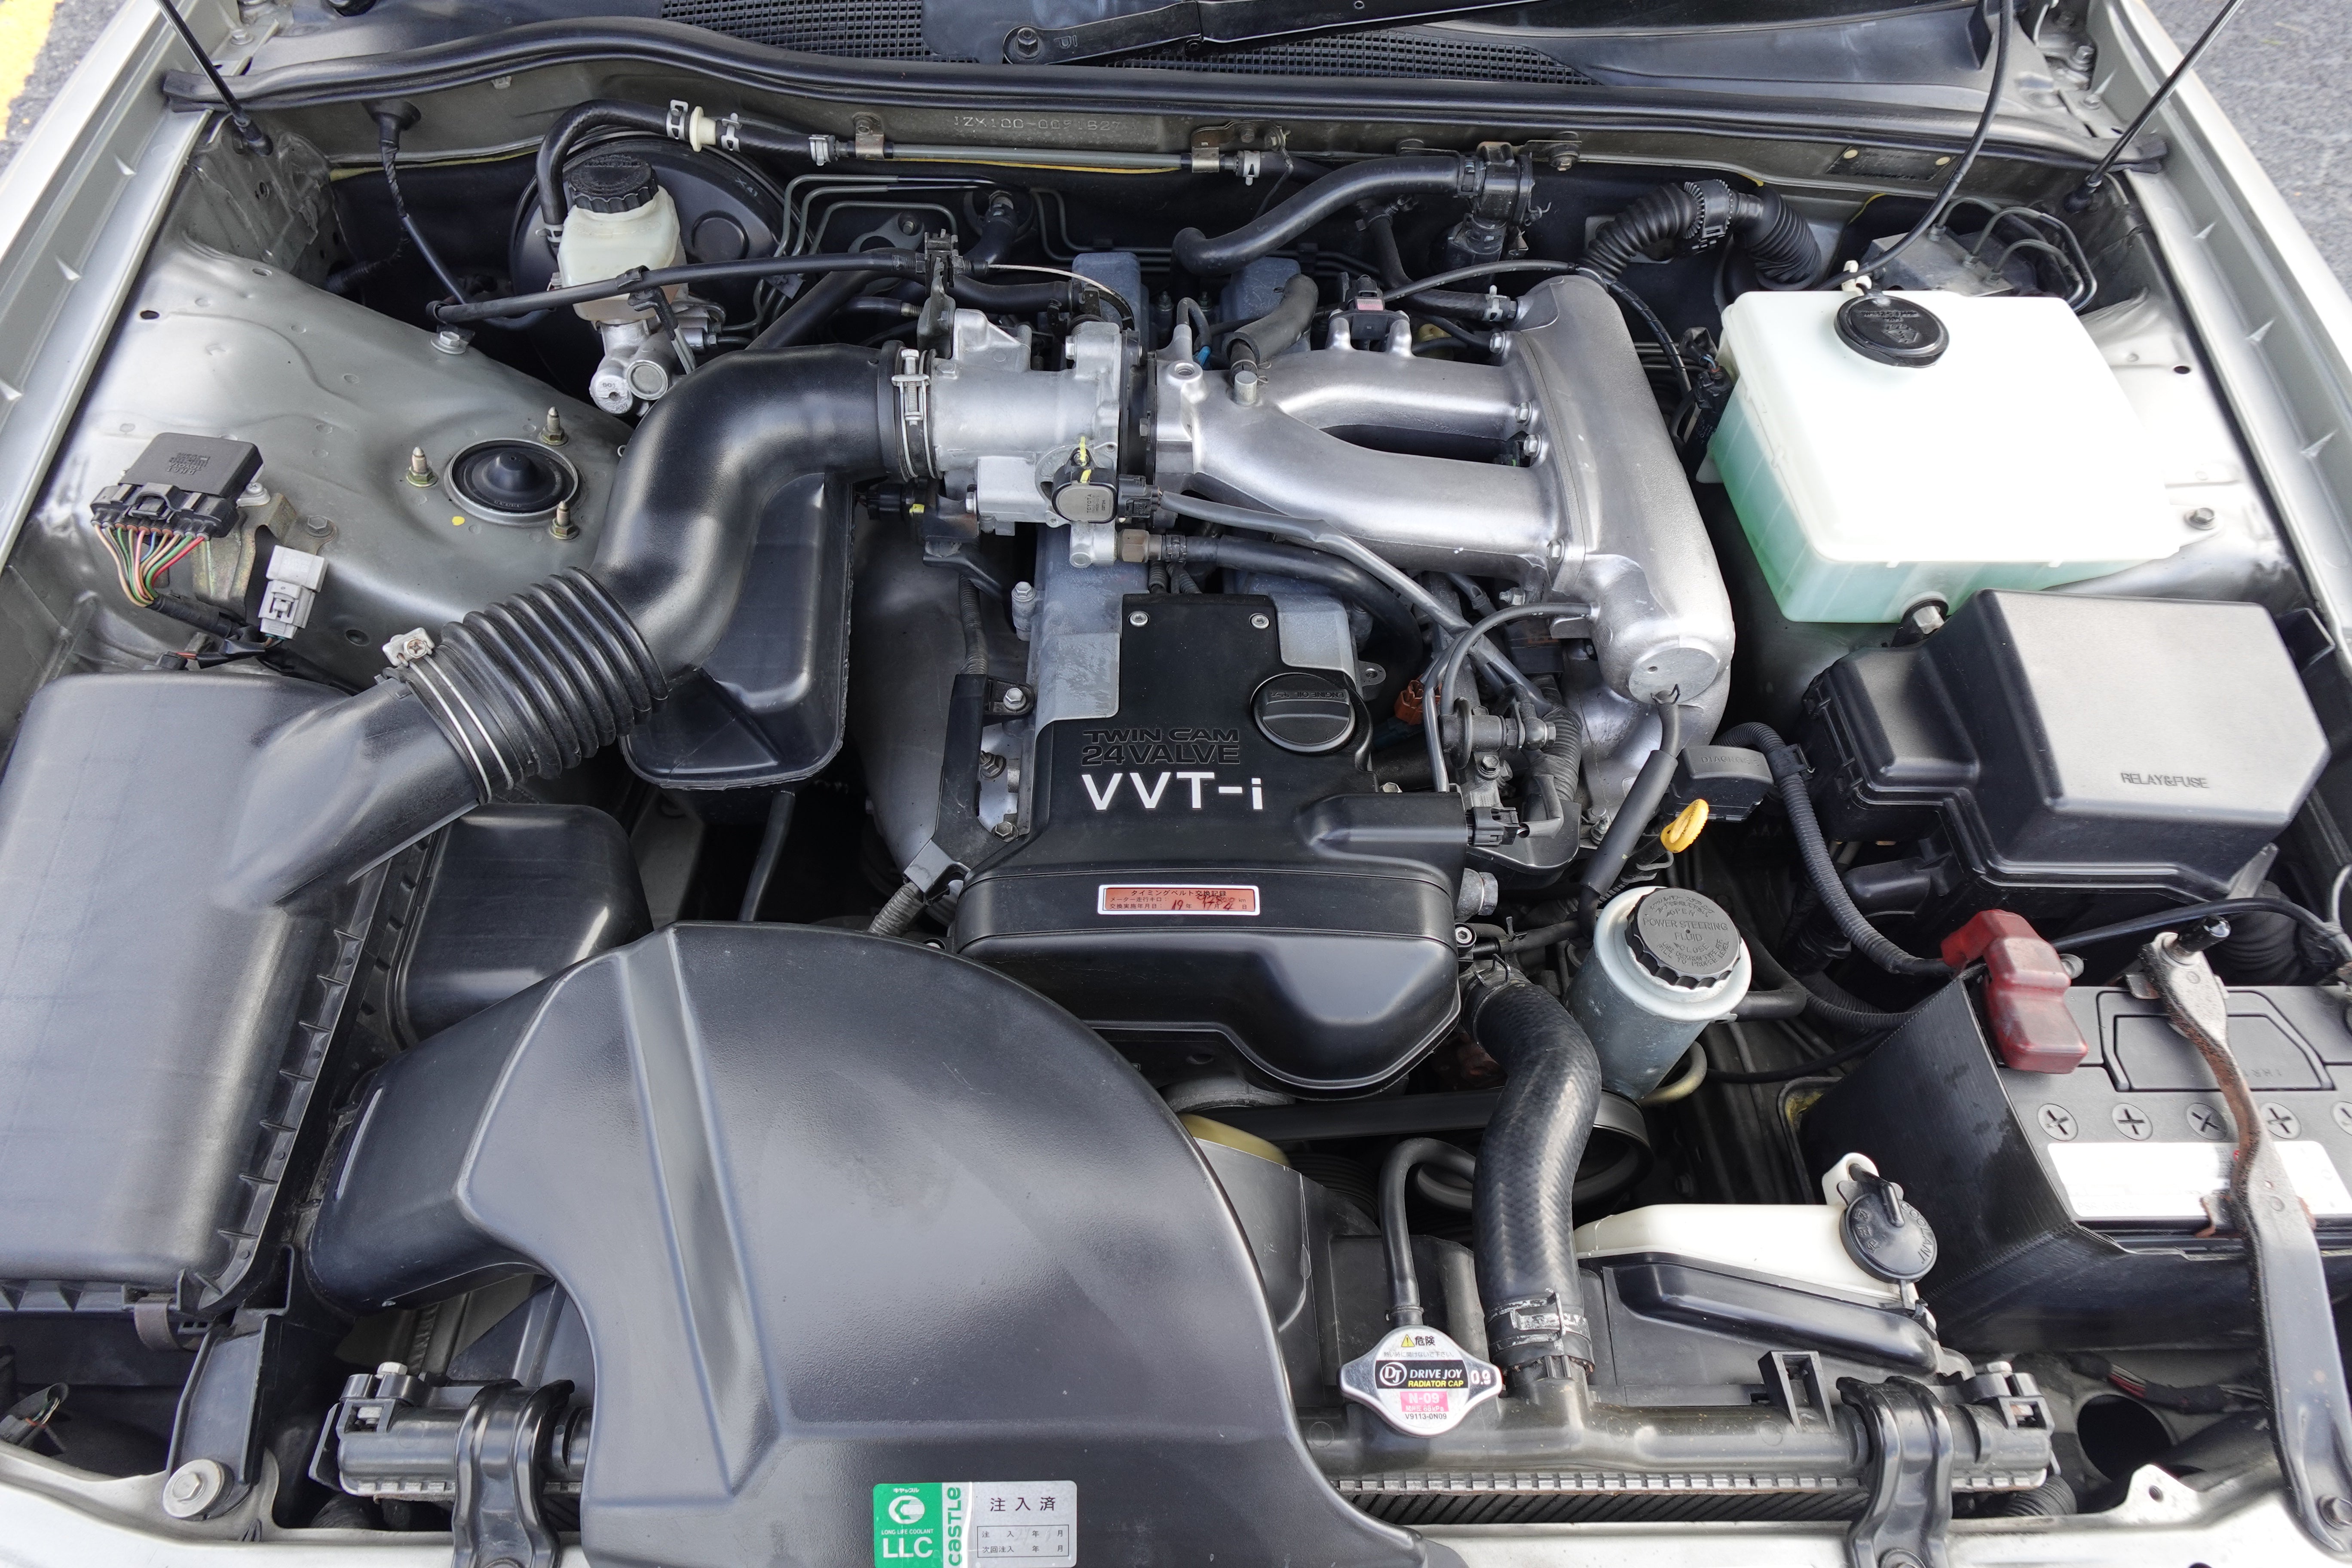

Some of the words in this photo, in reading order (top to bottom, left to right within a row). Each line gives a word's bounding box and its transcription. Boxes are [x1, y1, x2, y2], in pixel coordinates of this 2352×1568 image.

[1083, 729, 1162, 744] TWIN
[1168, 728, 1240, 742] CAM
[2121, 773, 2210, 788] RELAY&FUSE
[1081, 772, 1263, 811] VVT-i
[1171, 900, 1184, 910] 19
[1223, 902, 1235, 910] 4
[1670, 908, 1696, 917] OPEN
[1643, 918, 1677, 928] POWER
[1679, 921, 1728, 931] STEERING
[1674, 932, 1703, 942] FLUID
[1657, 943, 1673, 959] FILL
[1691, 958, 1718, 967] PROPER
[1662, 941, 1675, 953] USE
[1702, 949, 1719, 961] TYPE
[1680, 943, 1710, 954] CLOSE
[1901, 1202, 1933, 1265] COOLANT
[1415, 1335, 1436, 1346] 危険
[1384, 1366, 1402, 1384] DJ
[1410, 1369, 1441, 1378] DRIVE
[1442, 1369, 1462, 1380] JOY
[1470, 1370, 1491, 1385] 0.9
[1409, 1393, 1440, 1404] N-09
[990, 1496, 1056, 1512] 注入済
[883, 1536, 933, 1558] LLC
